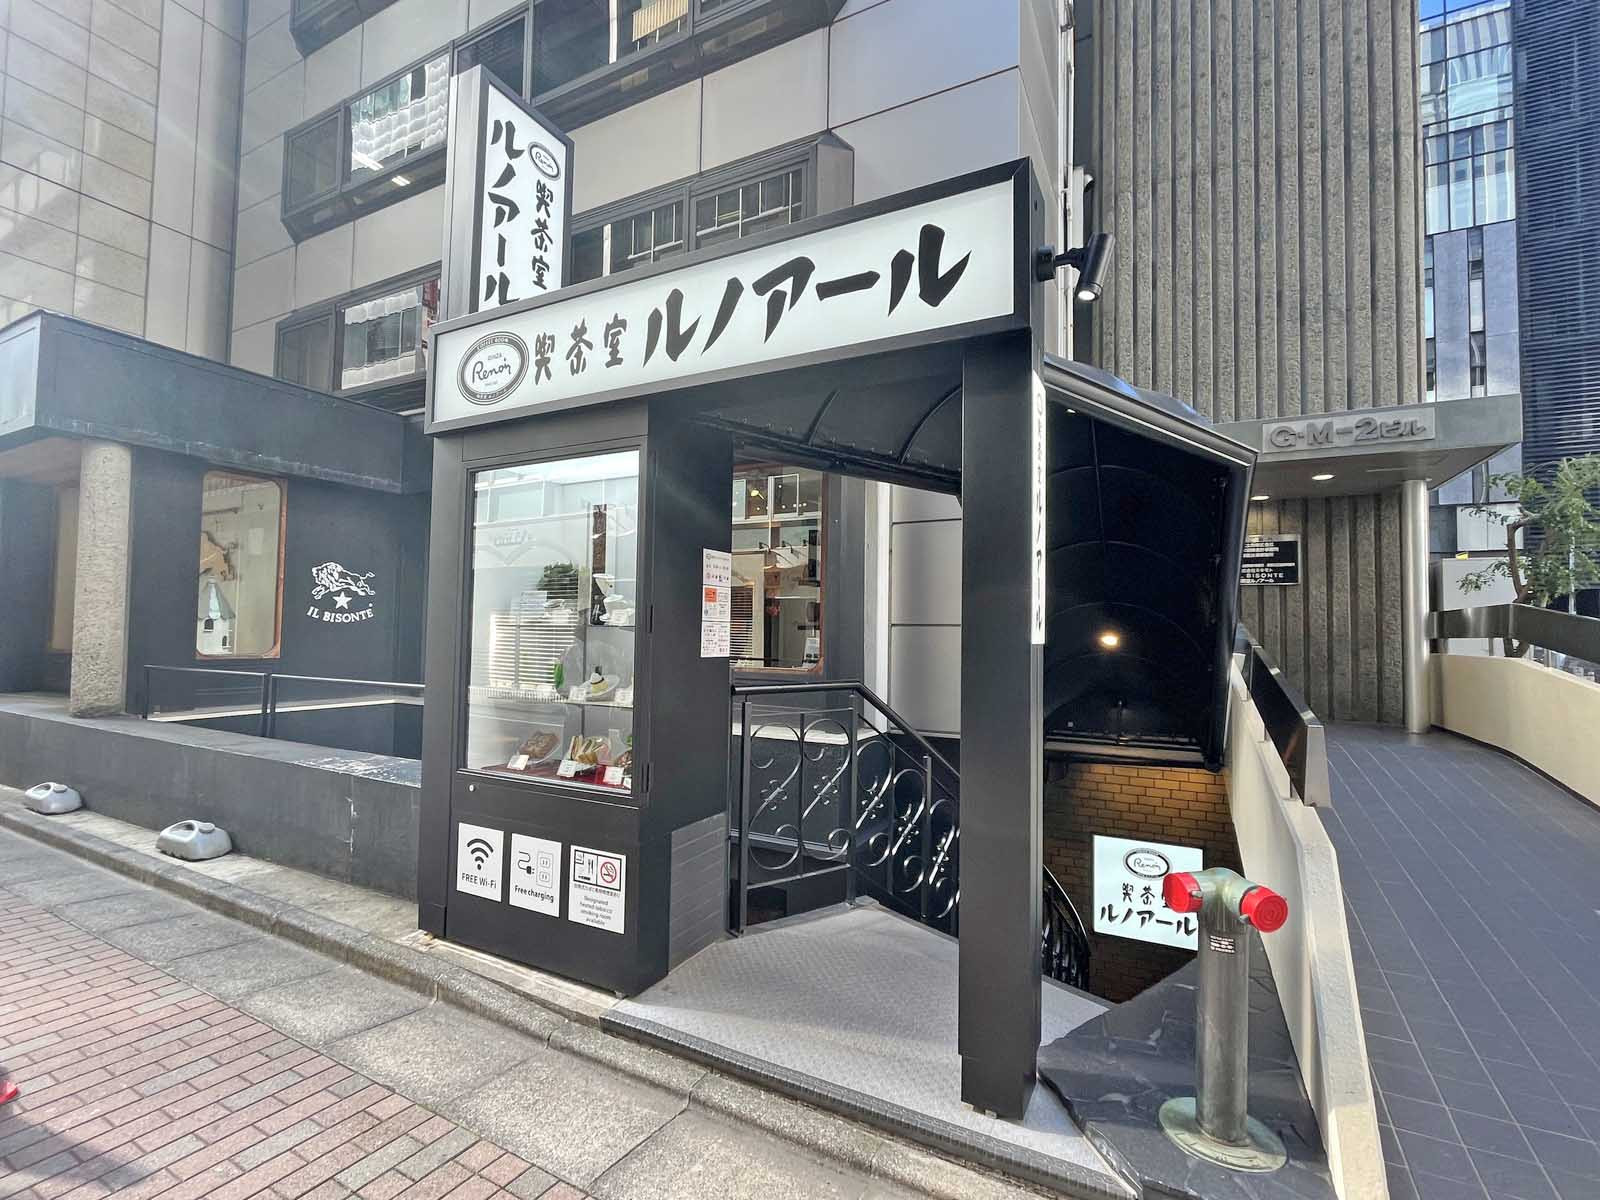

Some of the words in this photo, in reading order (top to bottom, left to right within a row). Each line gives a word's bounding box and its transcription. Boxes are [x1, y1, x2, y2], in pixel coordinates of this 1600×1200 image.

[484, 119, 526, 306] ルノアール
[530, 178, 554, 290] 喫茶室
[534, 313, 627, 385] 喫茶室
[643, 224, 972, 367] ルノアール
[306, 606, 320, 619] IL
[322, 608, 374, 623] BISONTE
[461, 872, 478, 885] FREE
[479, 877, 497, 889] Wi-Fi
[514, 884, 528, 896] Free
[527, 888, 554, 904] charging
[1122, 882, 1169, 908] 喫茶
[1100, 903, 1197, 936] ルノアール
